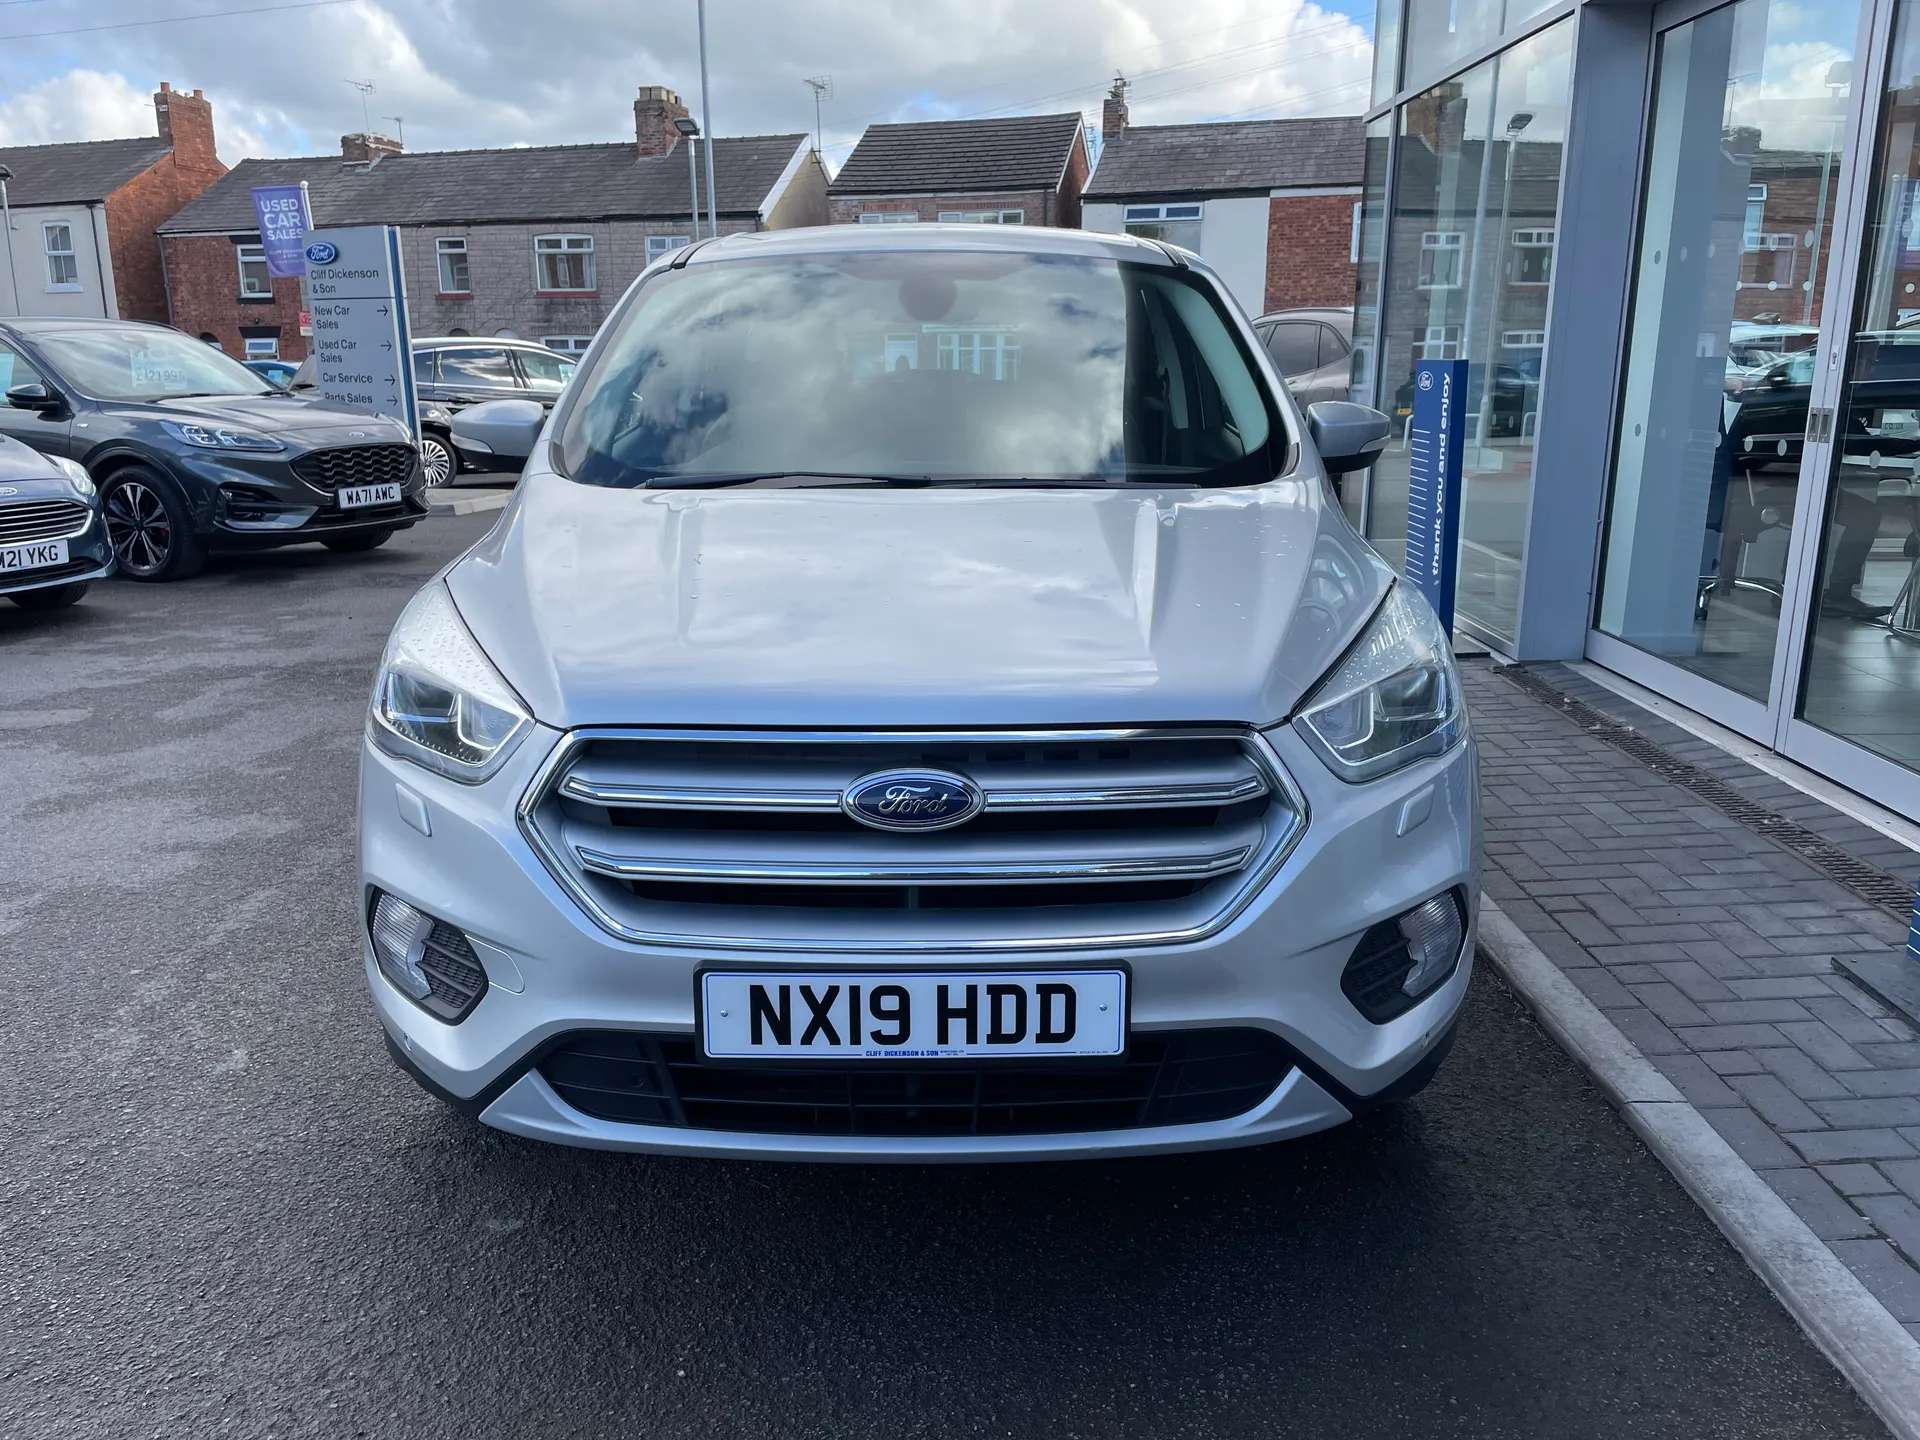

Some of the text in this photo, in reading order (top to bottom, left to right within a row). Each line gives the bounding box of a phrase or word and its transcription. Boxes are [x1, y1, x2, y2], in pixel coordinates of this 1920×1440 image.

[260, 199, 299, 212] USED
[264, 211, 302, 229] CAR
[266, 228, 304, 241] SALES
[311, 268, 379, 280] Cliff Dickenson
[312, 283, 336, 294] & Son
[314, 305, 350, 316] New Car
[316, 320, 339, 330] Sales
[318, 339, 357, 350] Used Car
[320, 353, 343, 363] Sales
[322, 372, 373, 384] Car Service
[346, 392, 373, 404] Sales
[1432, 372, 1451, 576] thank you and enjoy
[346, 486, 395, 505] WA71 AWC
[26, 545, 59, 565] YKG
[878, 785, 948, 814] Ford
[749, 983, 1077, 1046] NX19 HDD
